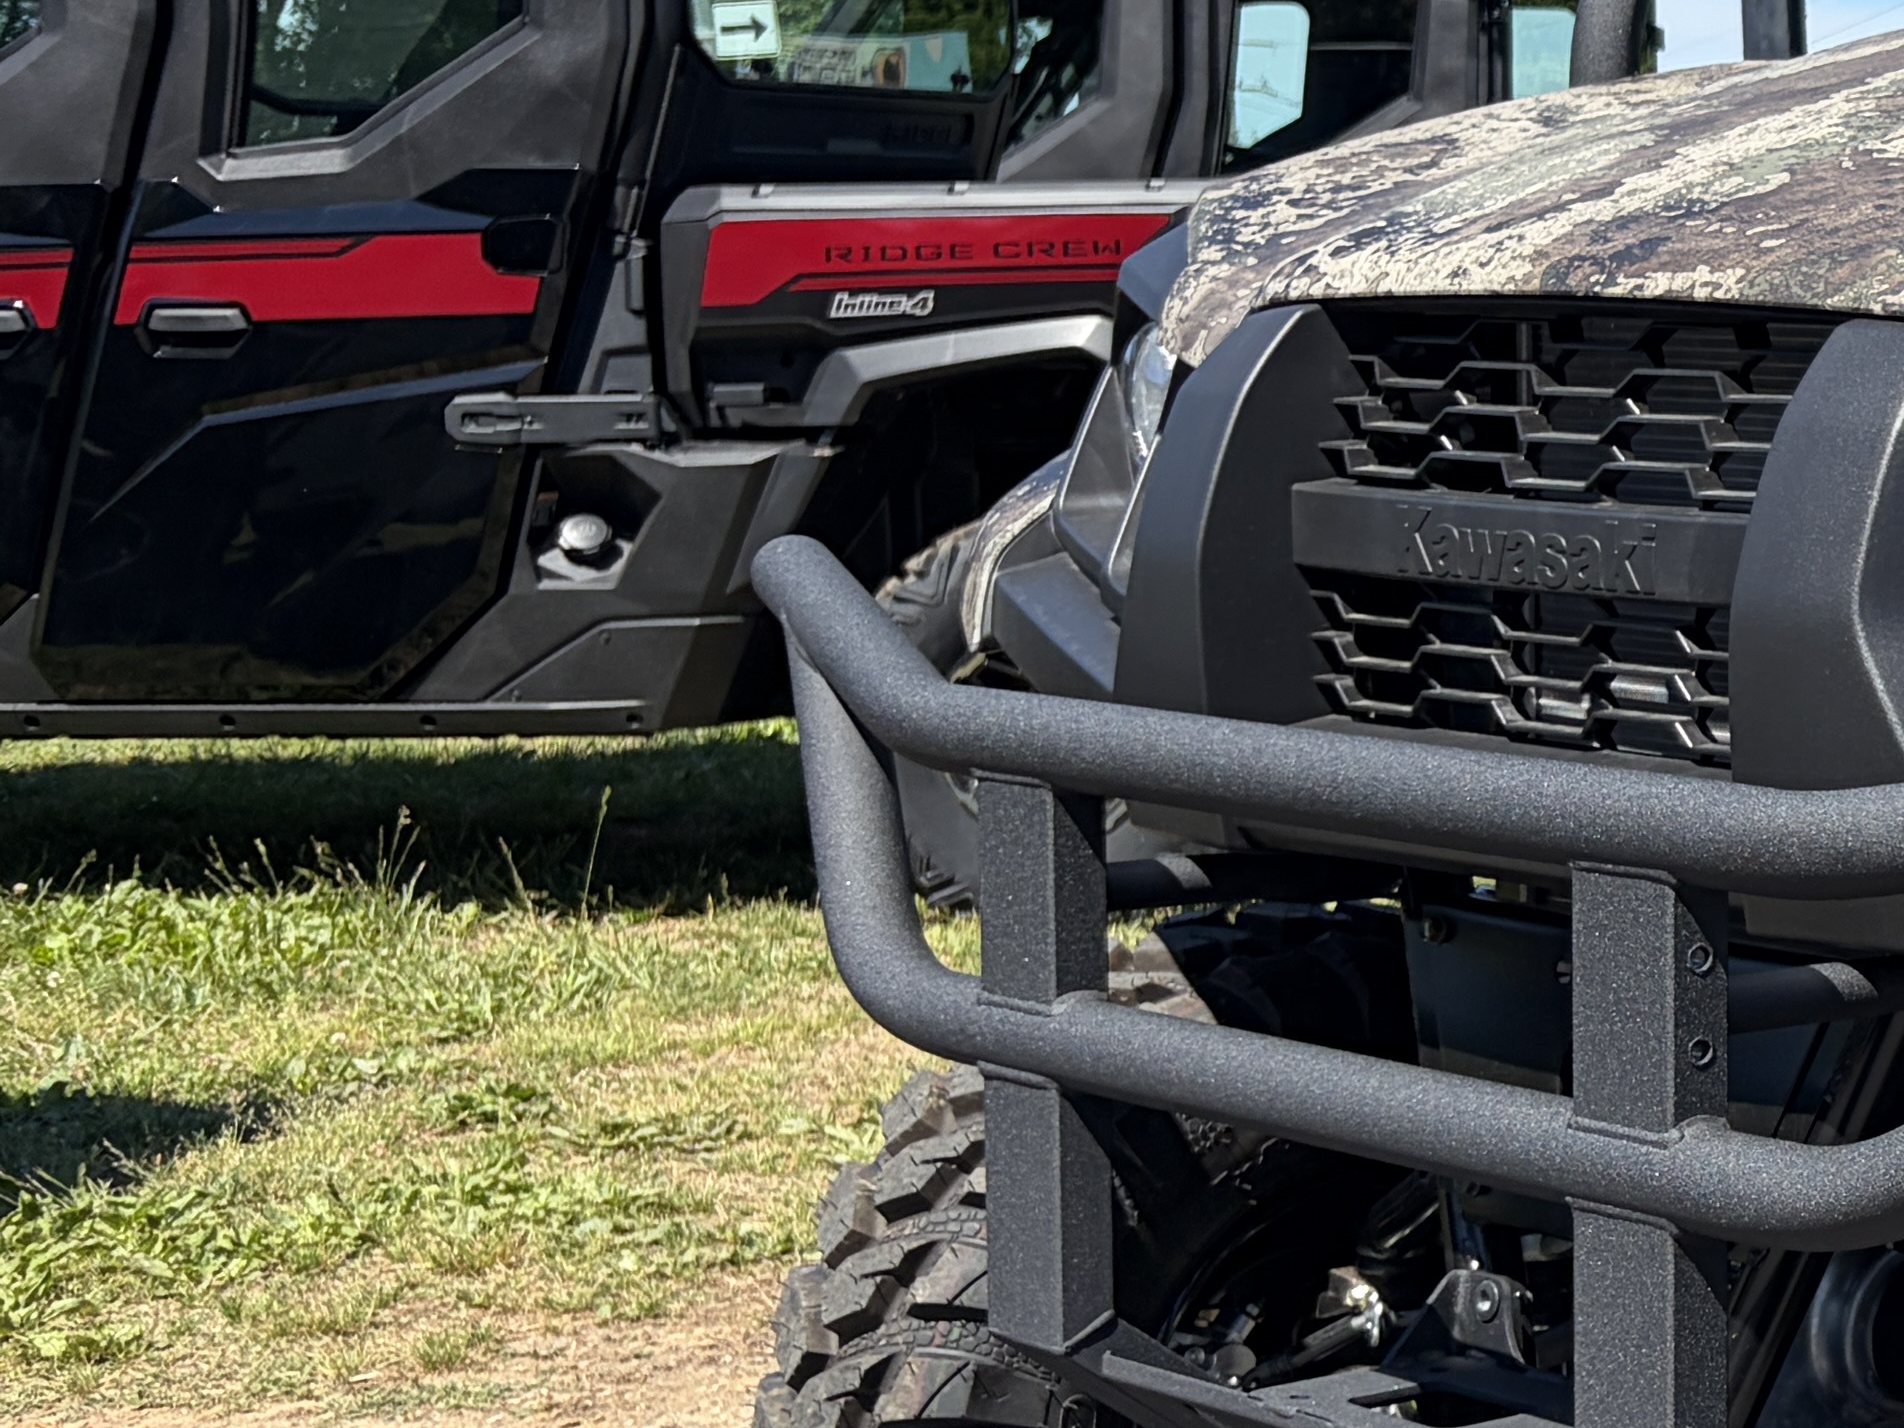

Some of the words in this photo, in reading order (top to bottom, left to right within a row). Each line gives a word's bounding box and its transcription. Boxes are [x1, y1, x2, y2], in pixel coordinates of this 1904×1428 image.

[824, 243, 974, 263] RIDGE
[992, 238, 1121, 260] CREW
[1398, 504, 1657, 597] Kawasaki
